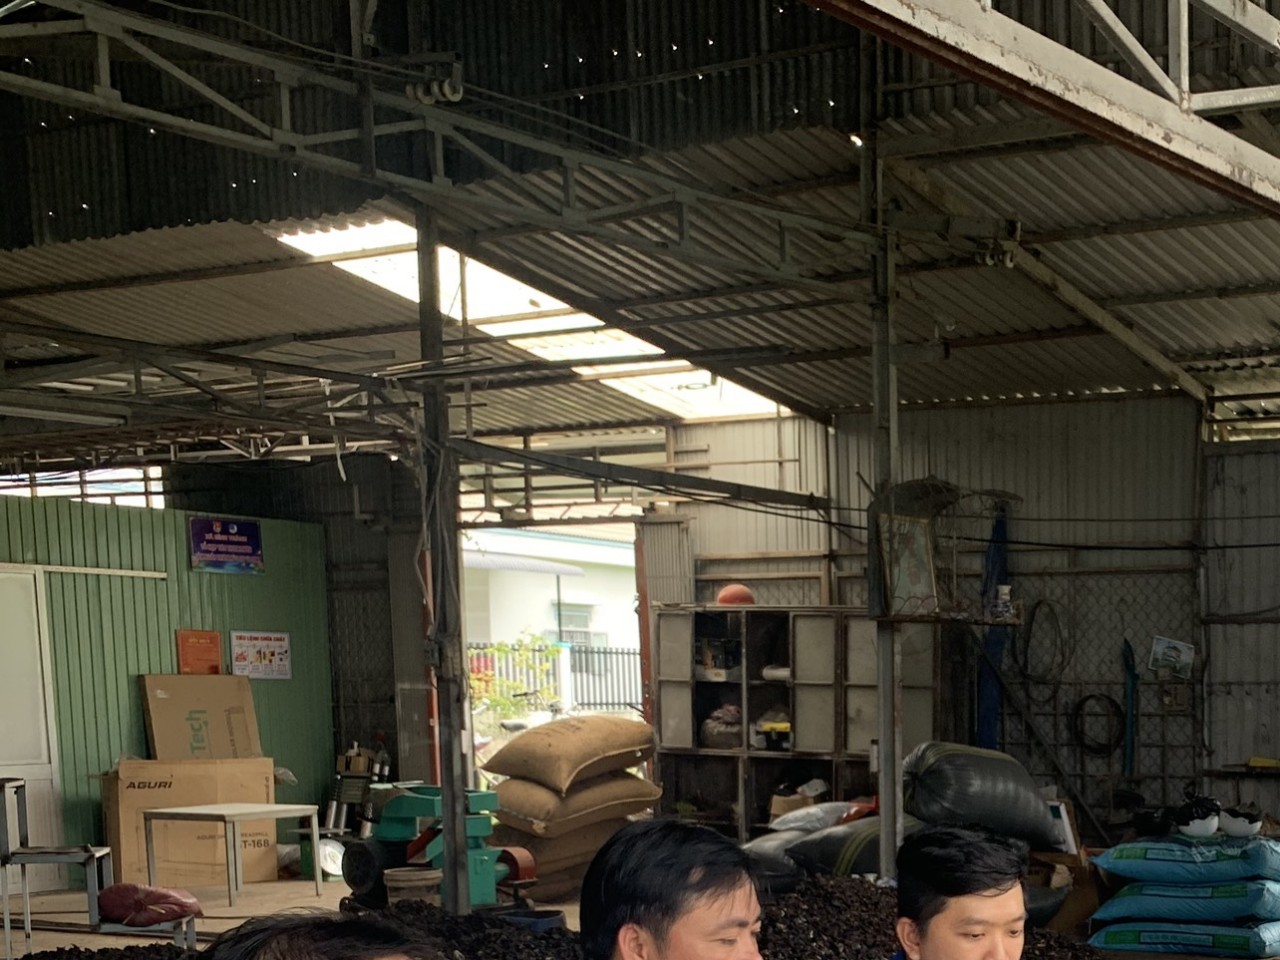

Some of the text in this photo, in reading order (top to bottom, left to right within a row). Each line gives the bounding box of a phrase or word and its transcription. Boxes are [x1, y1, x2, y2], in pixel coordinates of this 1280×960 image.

[186, 709, 207, 753] Tech
[126, 781, 172, 790] AGURI
[240, 839, 270, 849] T-168
